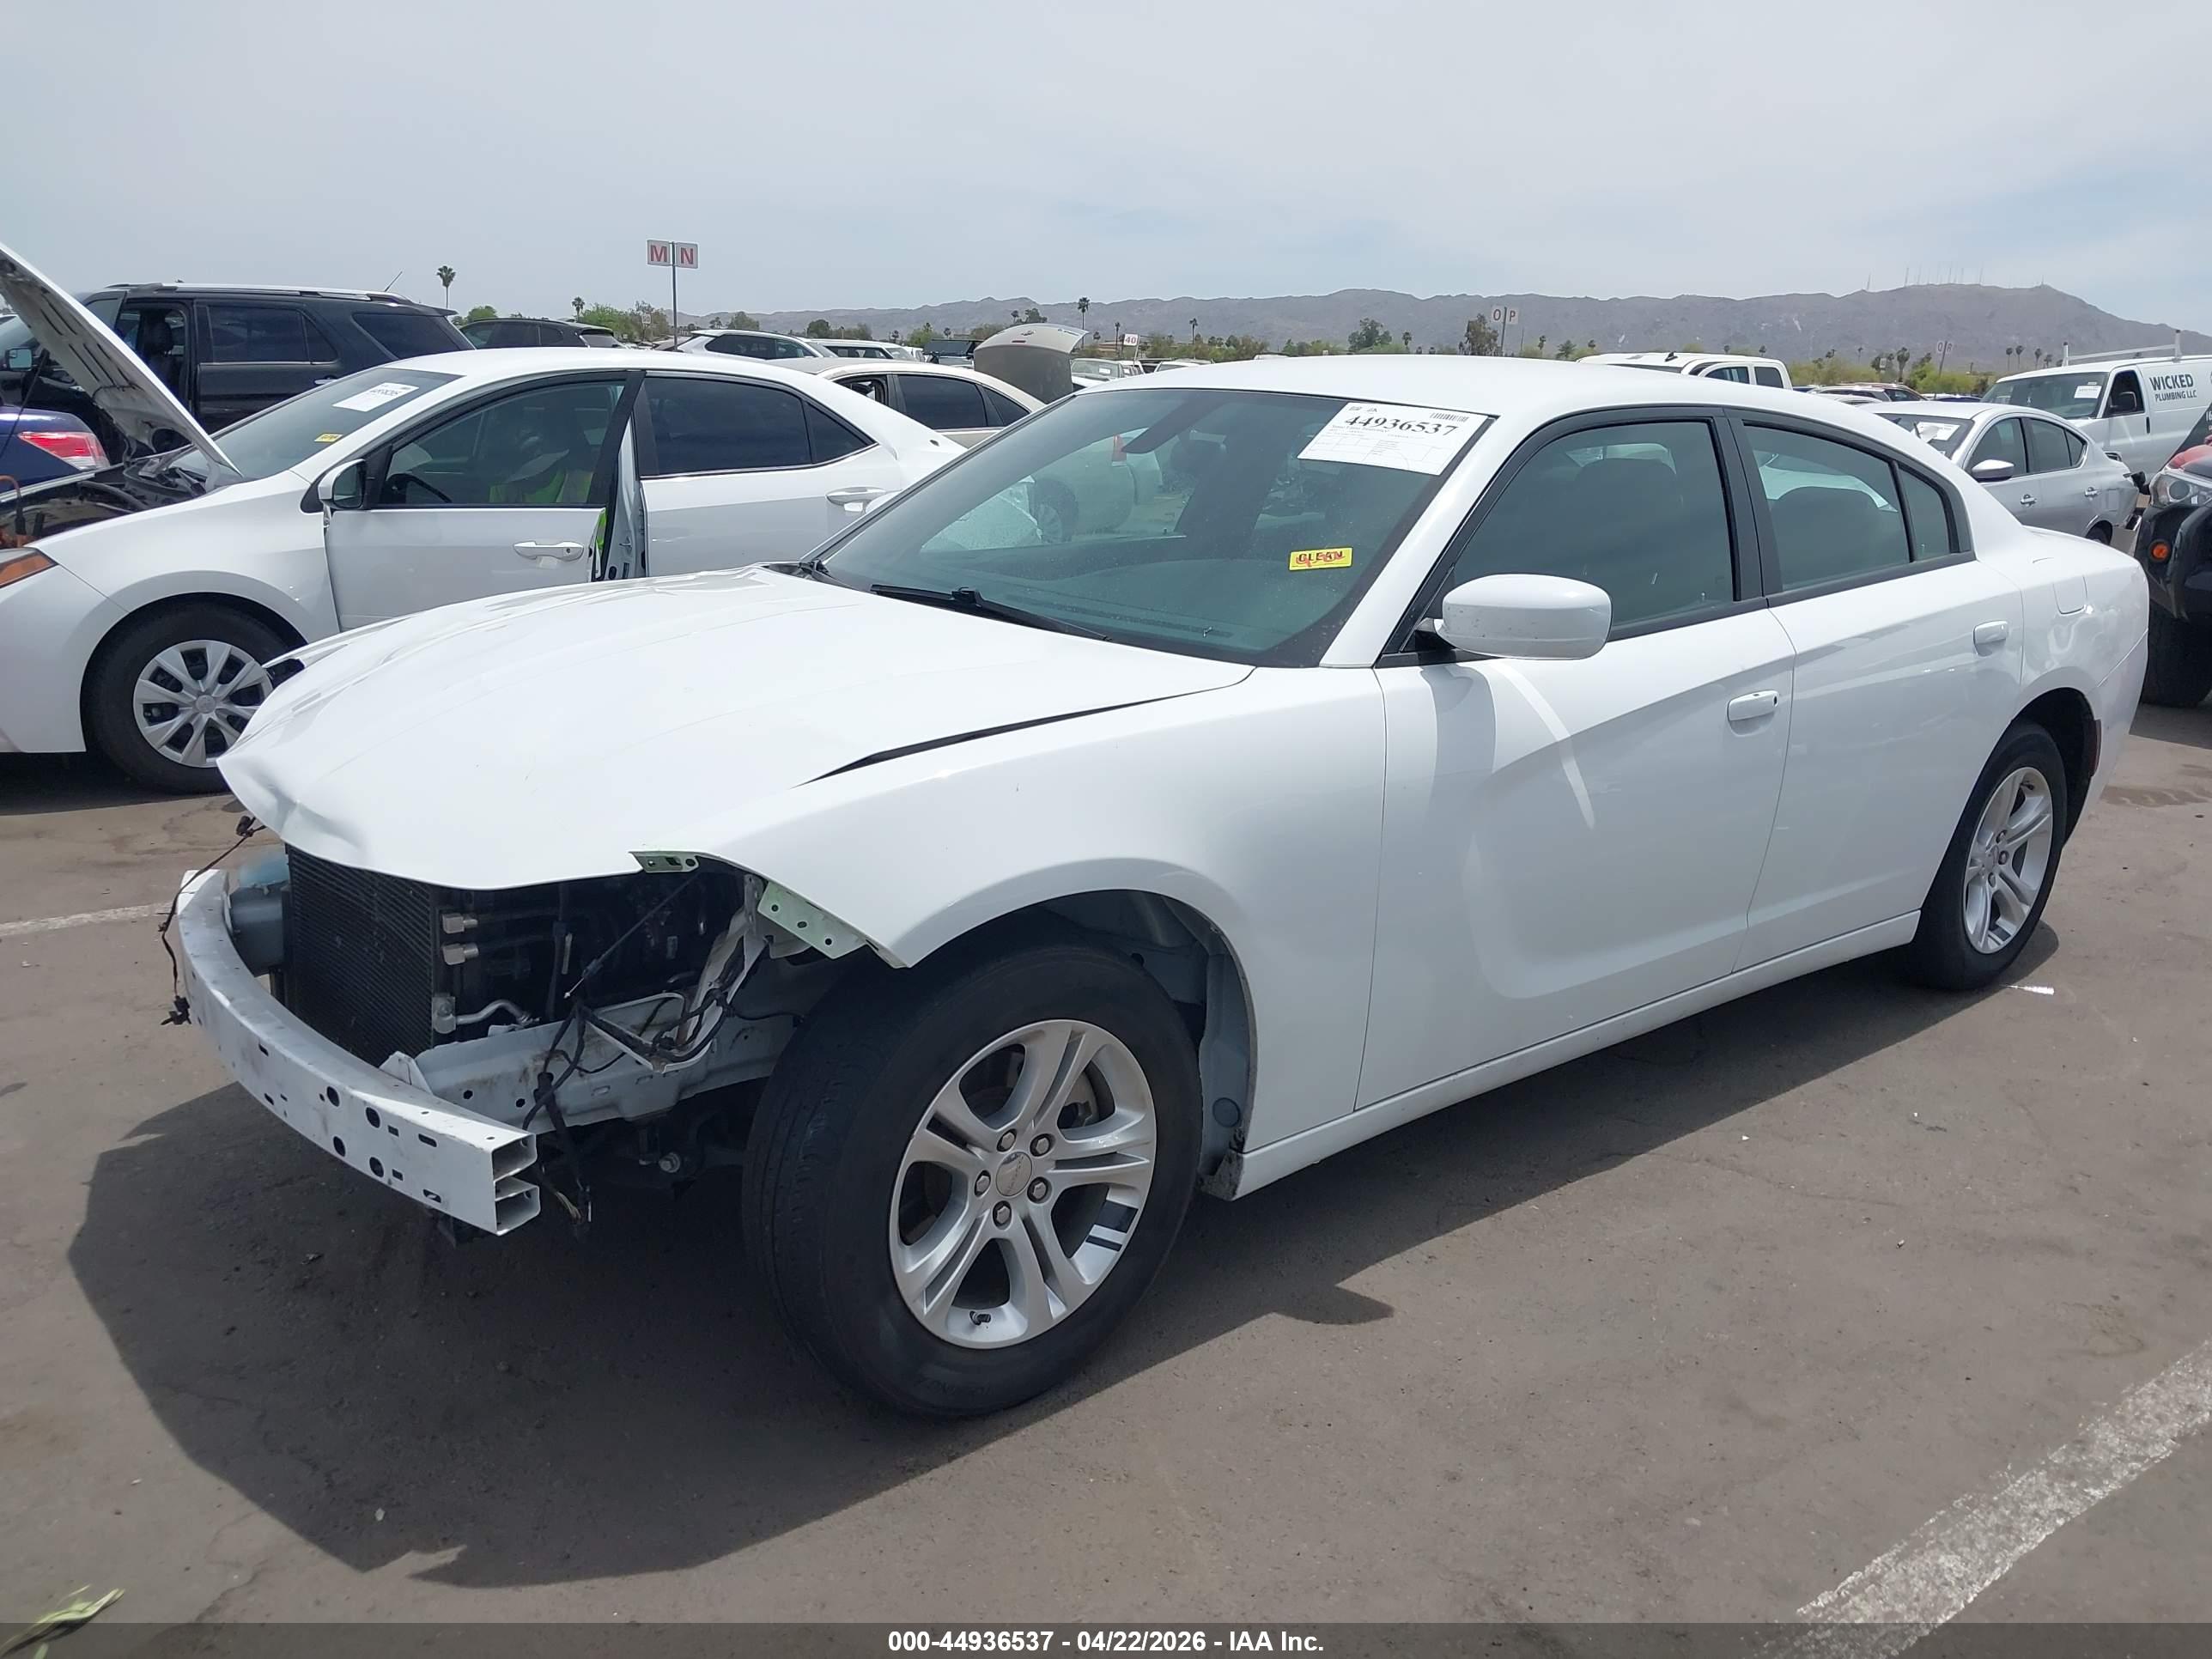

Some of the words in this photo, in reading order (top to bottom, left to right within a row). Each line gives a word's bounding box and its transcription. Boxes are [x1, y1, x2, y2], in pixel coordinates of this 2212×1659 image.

[650, 245, 668, 263] M
[680, 246, 694, 264] N
[1509, 310, 1516, 322] P
[2148, 374, 2194, 391] WICKED
[2154, 391, 2186, 402] PLUMBING
[2186, 389, 2197, 398] LLC
[1344, 416, 1460, 436] 44936537
